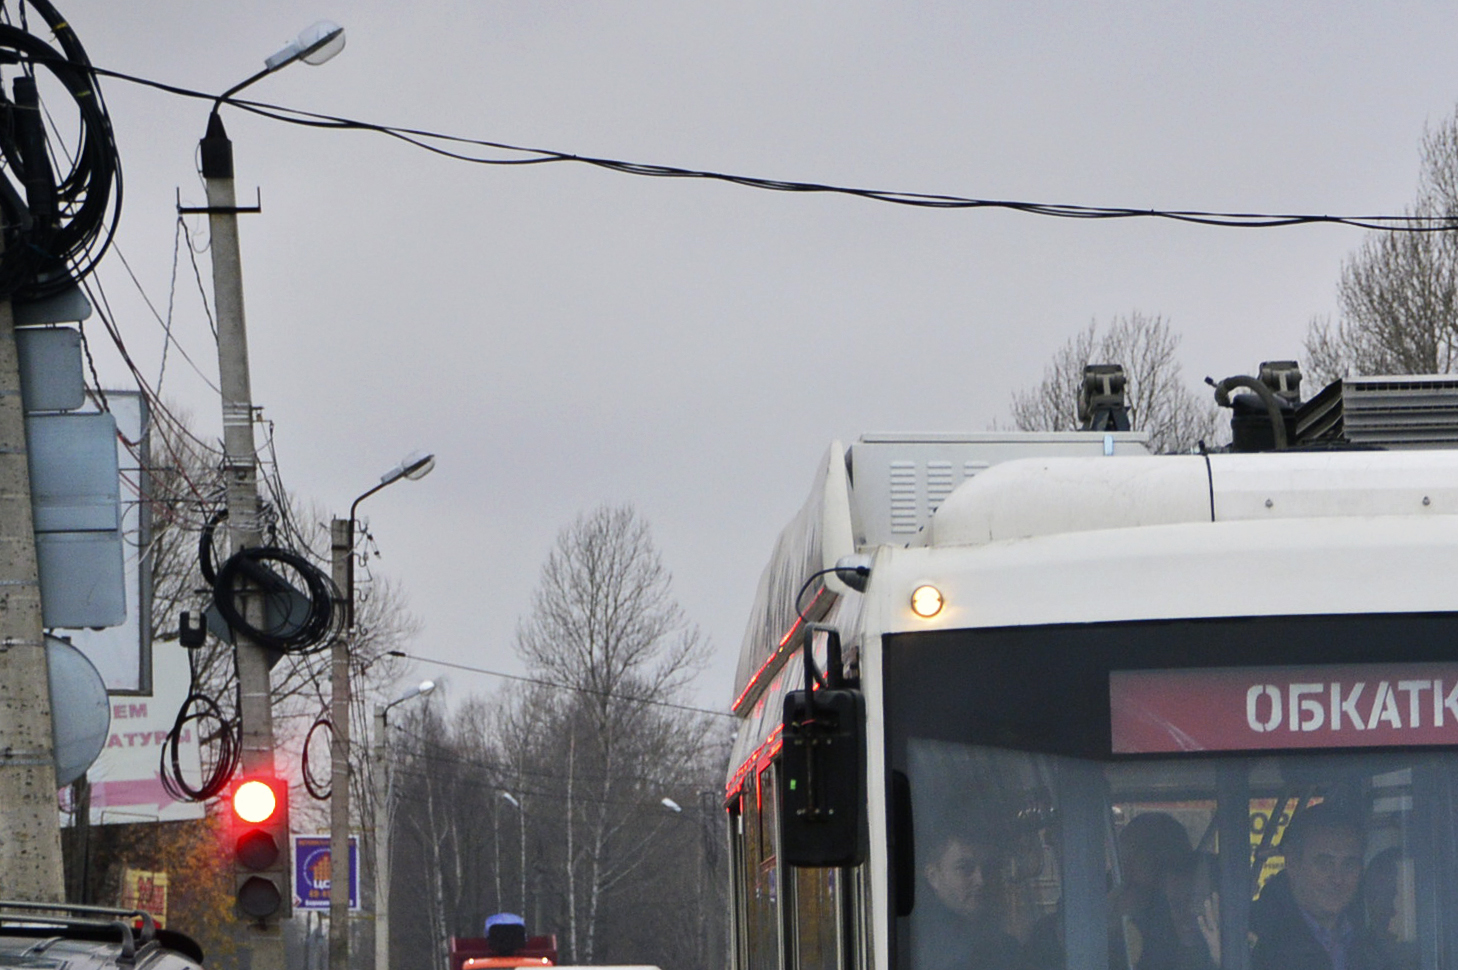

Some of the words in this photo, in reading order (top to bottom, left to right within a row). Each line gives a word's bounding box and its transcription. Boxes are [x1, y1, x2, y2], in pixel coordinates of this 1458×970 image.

[113, 703, 148, 719] ЕМ
[107, 728, 191, 748] АТУРЫ
[313, 879, 331, 890] ЦС
